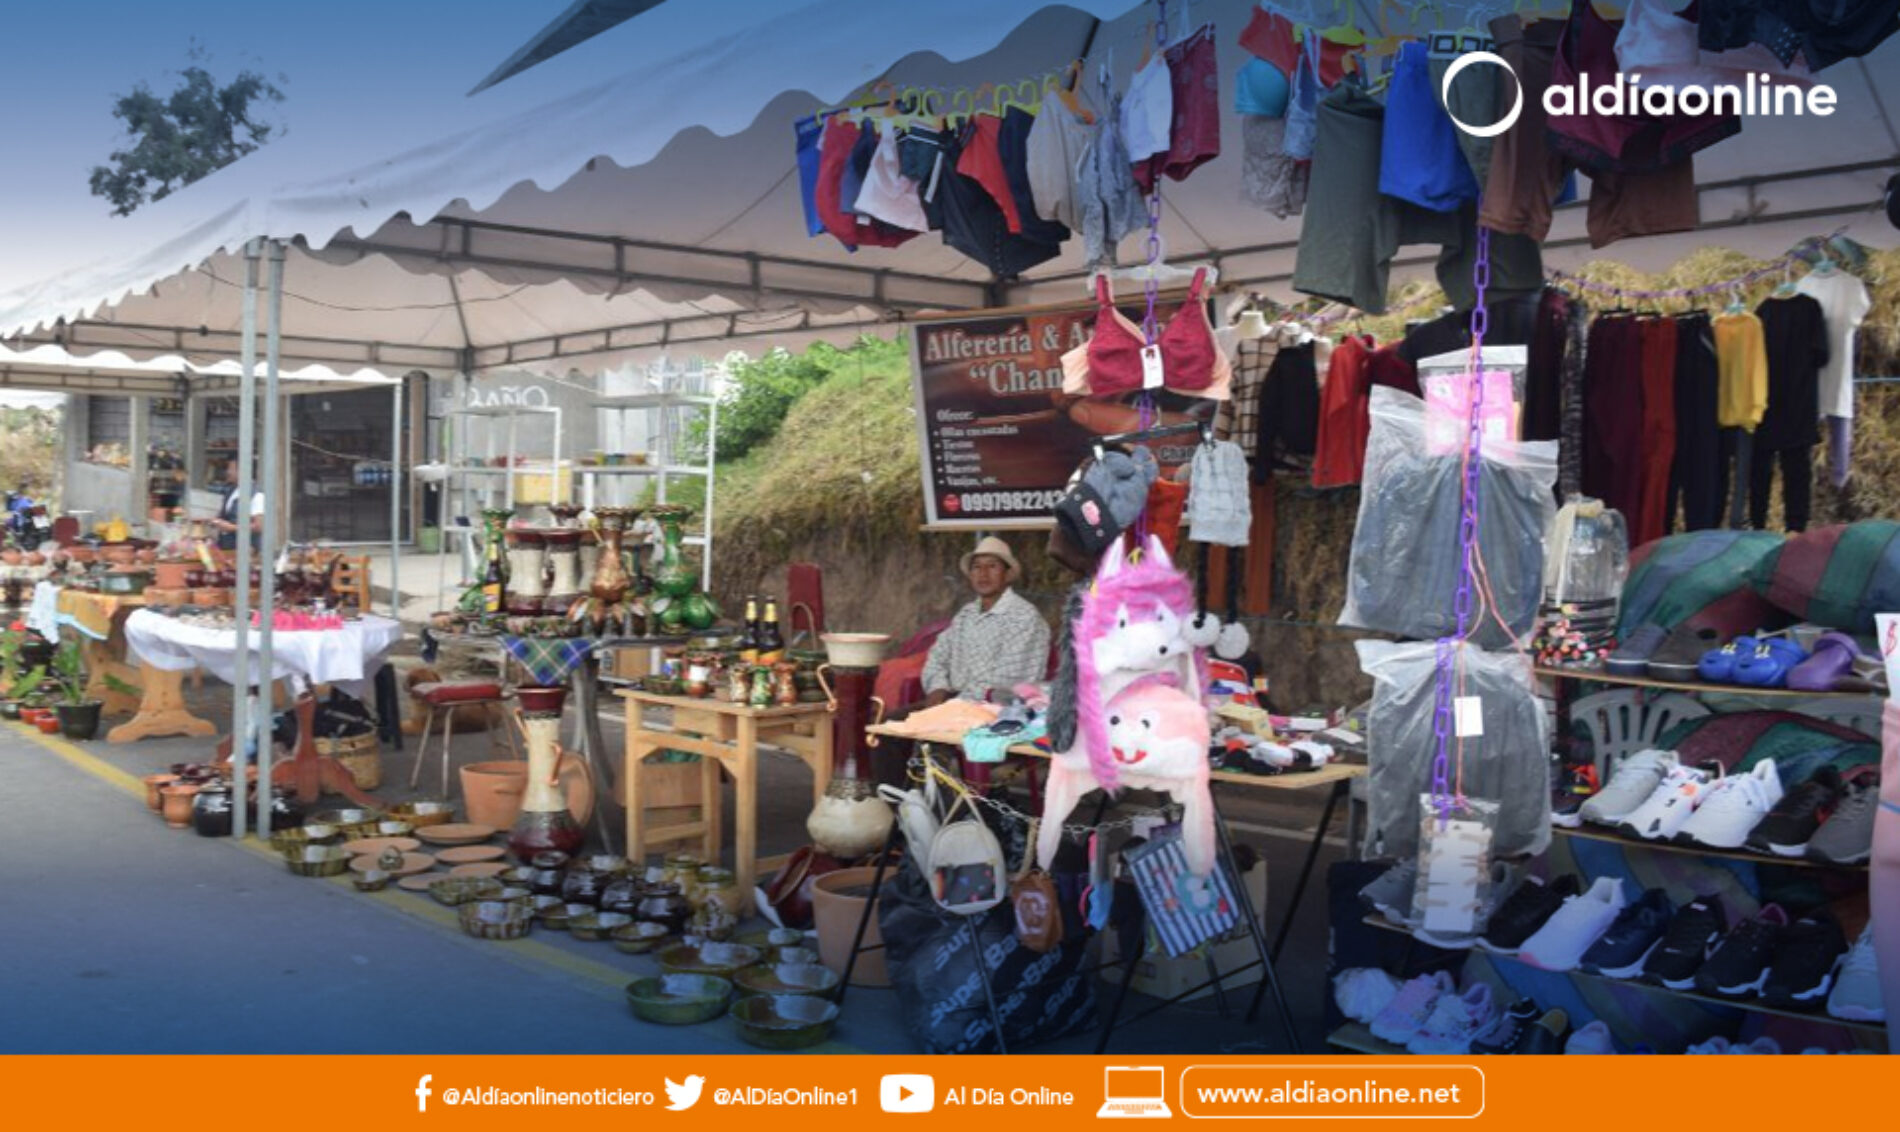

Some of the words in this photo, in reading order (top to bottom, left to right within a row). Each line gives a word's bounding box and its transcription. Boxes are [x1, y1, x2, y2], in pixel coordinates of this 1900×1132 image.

[926, 327, 1032, 359] Alferería
[1042, 323, 1060, 350] &
[969, 361, 1064, 394] “Chan
